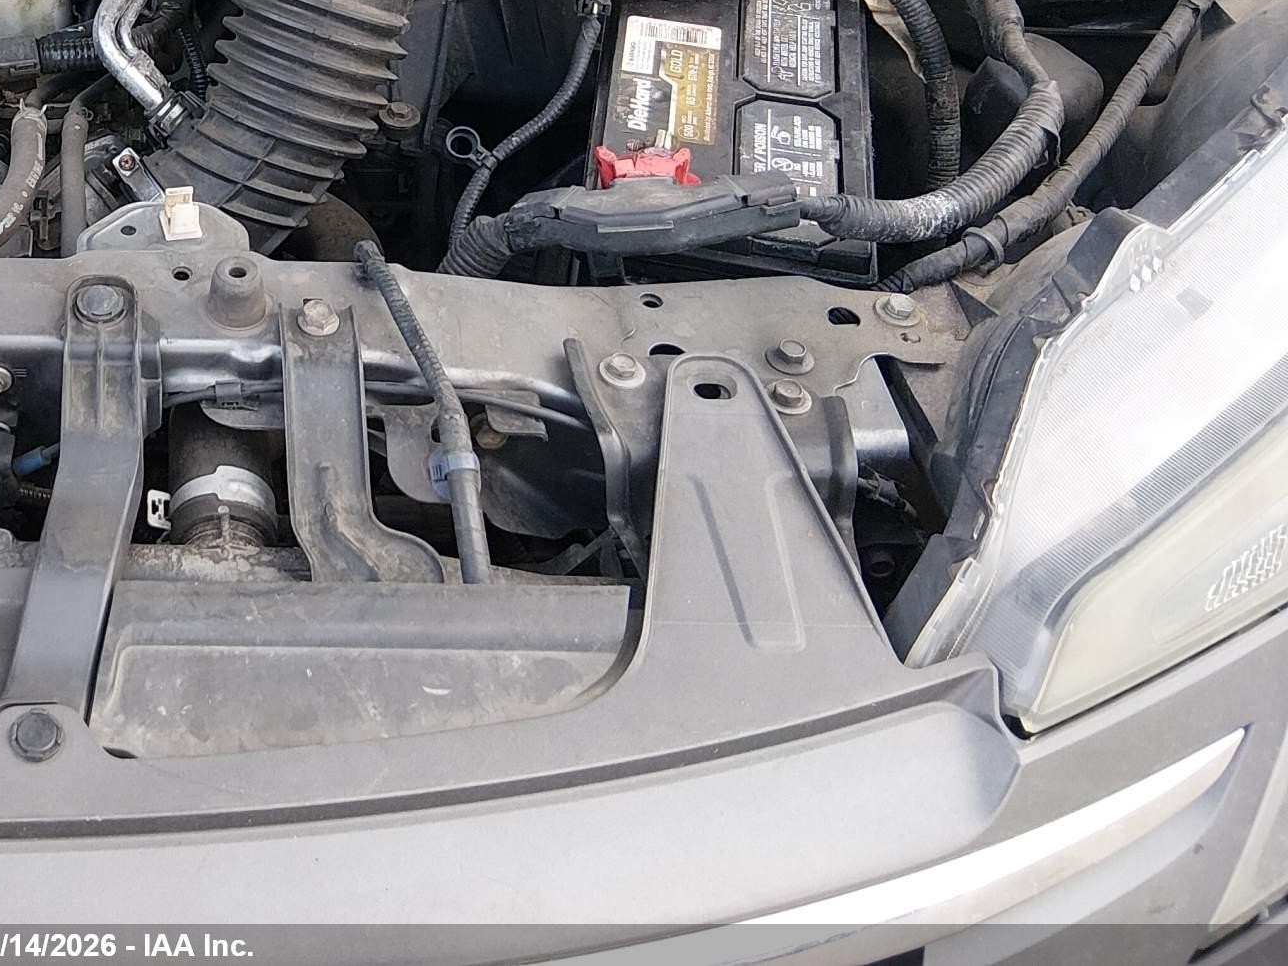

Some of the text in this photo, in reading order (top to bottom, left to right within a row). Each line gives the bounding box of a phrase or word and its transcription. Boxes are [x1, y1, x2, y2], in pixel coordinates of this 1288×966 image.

[670, 49, 683, 75] GOLD
[629, 79, 653, 132] DieHard
[754, 123, 766, 155] POISON
